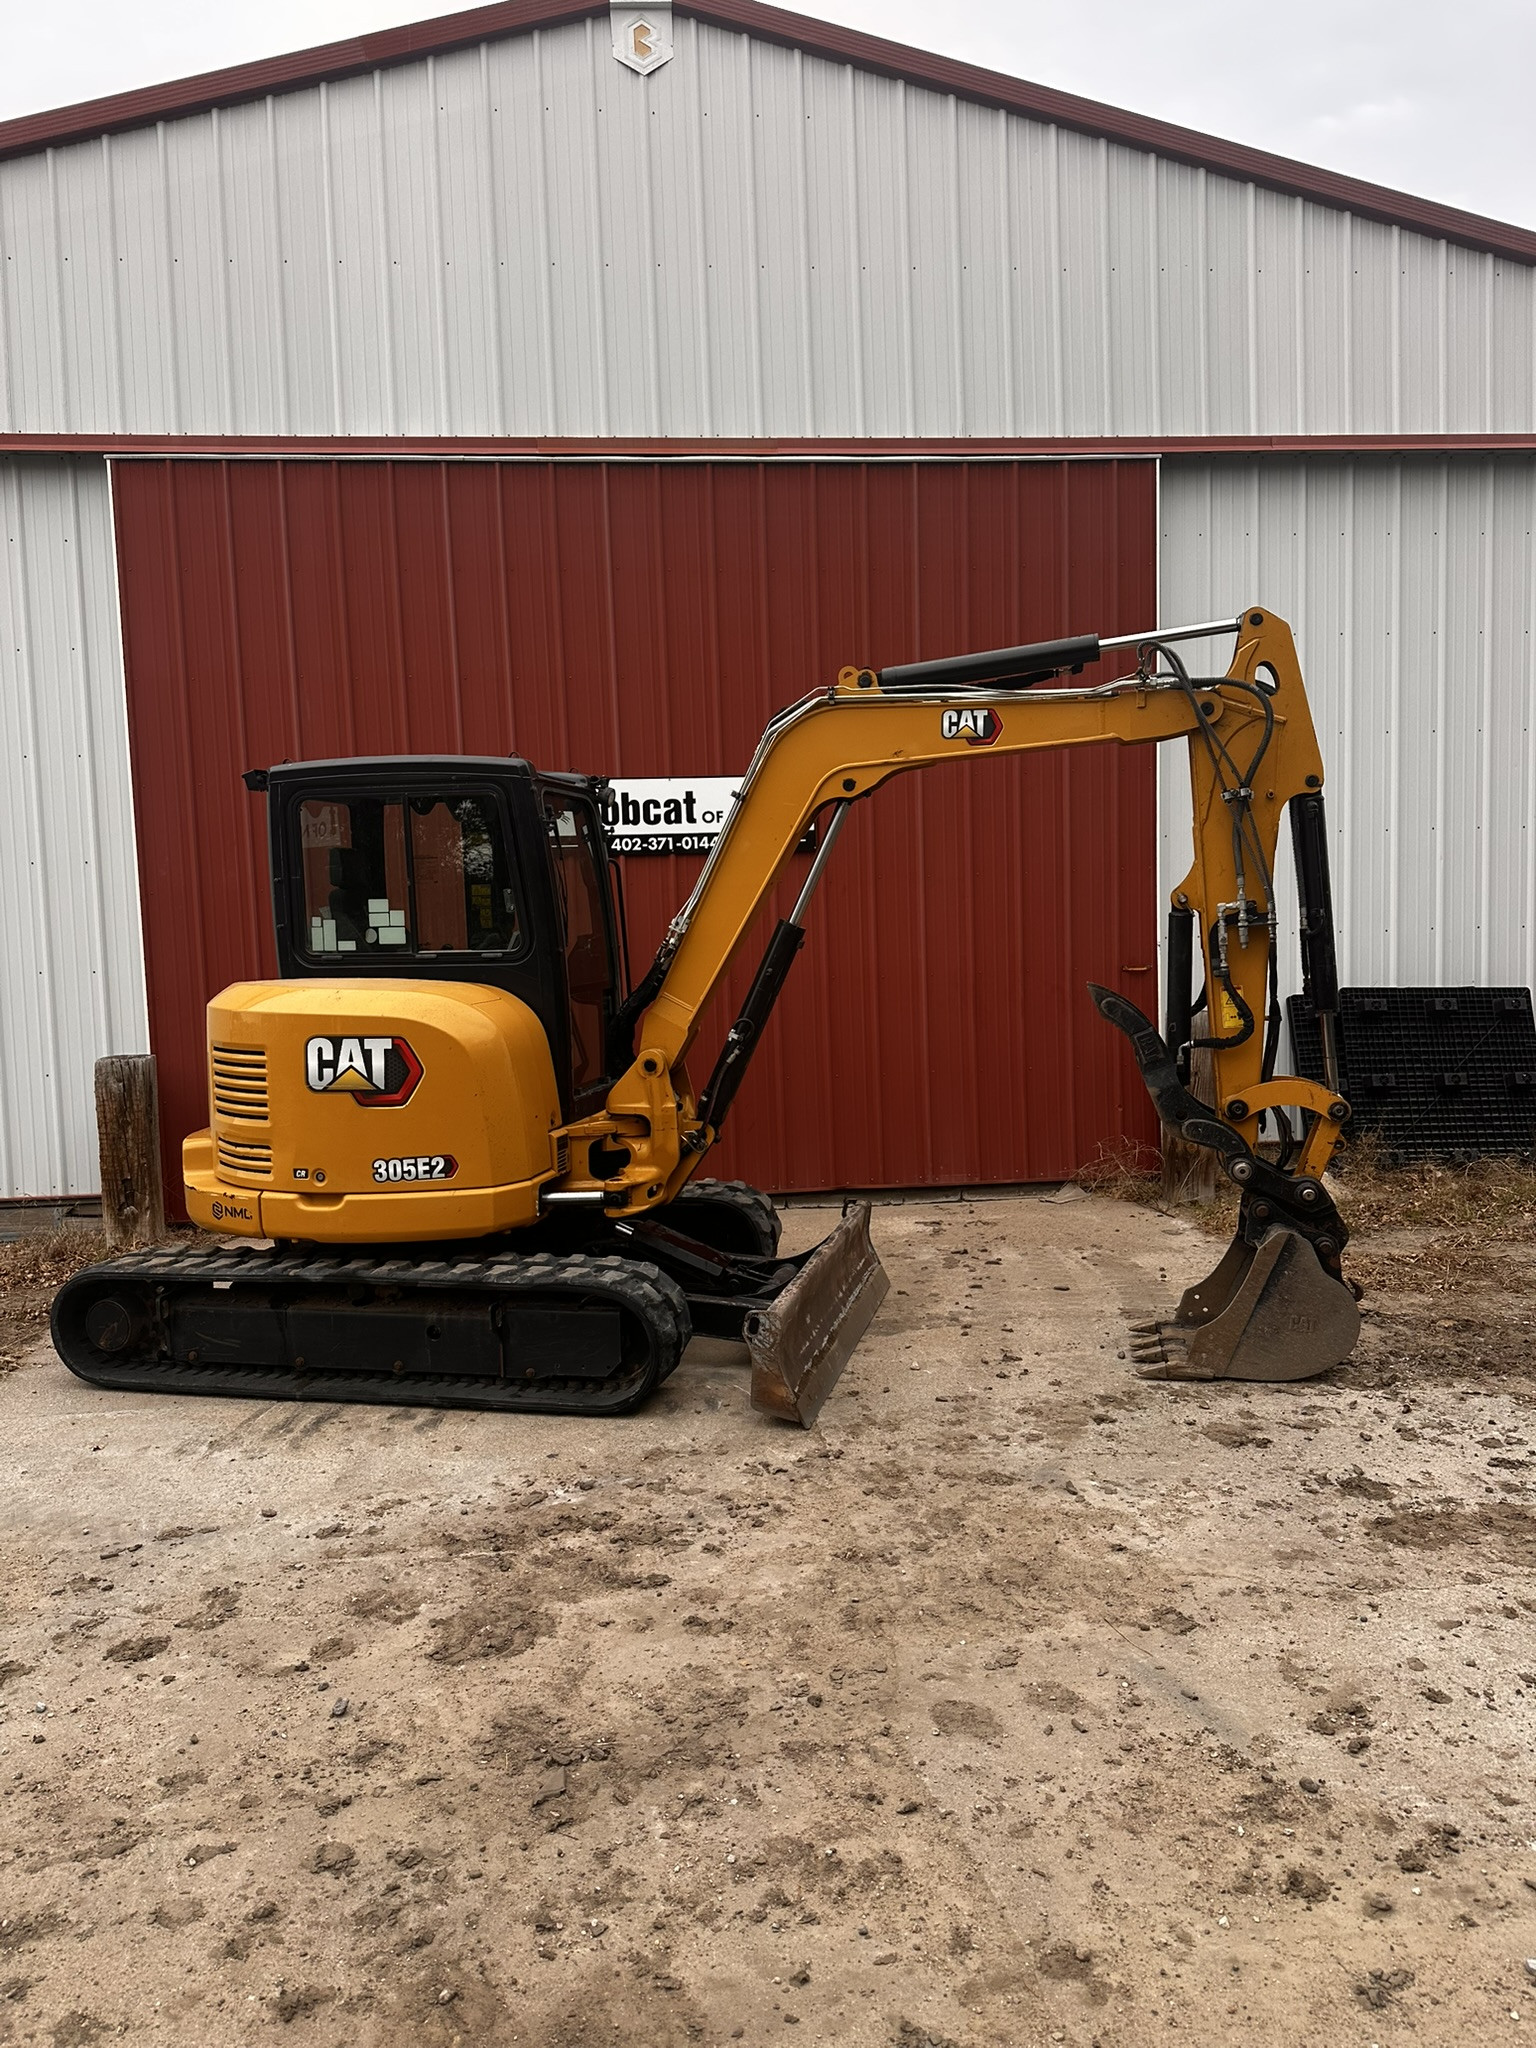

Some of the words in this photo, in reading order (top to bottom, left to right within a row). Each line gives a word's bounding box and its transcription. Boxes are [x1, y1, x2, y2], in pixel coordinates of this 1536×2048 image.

[943, 709, 988, 738] CAT
[601, 790, 697, 826] obcat
[701, 810, 724, 824] OF
[306, 1036, 394, 1091] CAT
[295, 1169, 307, 1178] CR
[372, 1156, 446, 1183] 305E2
